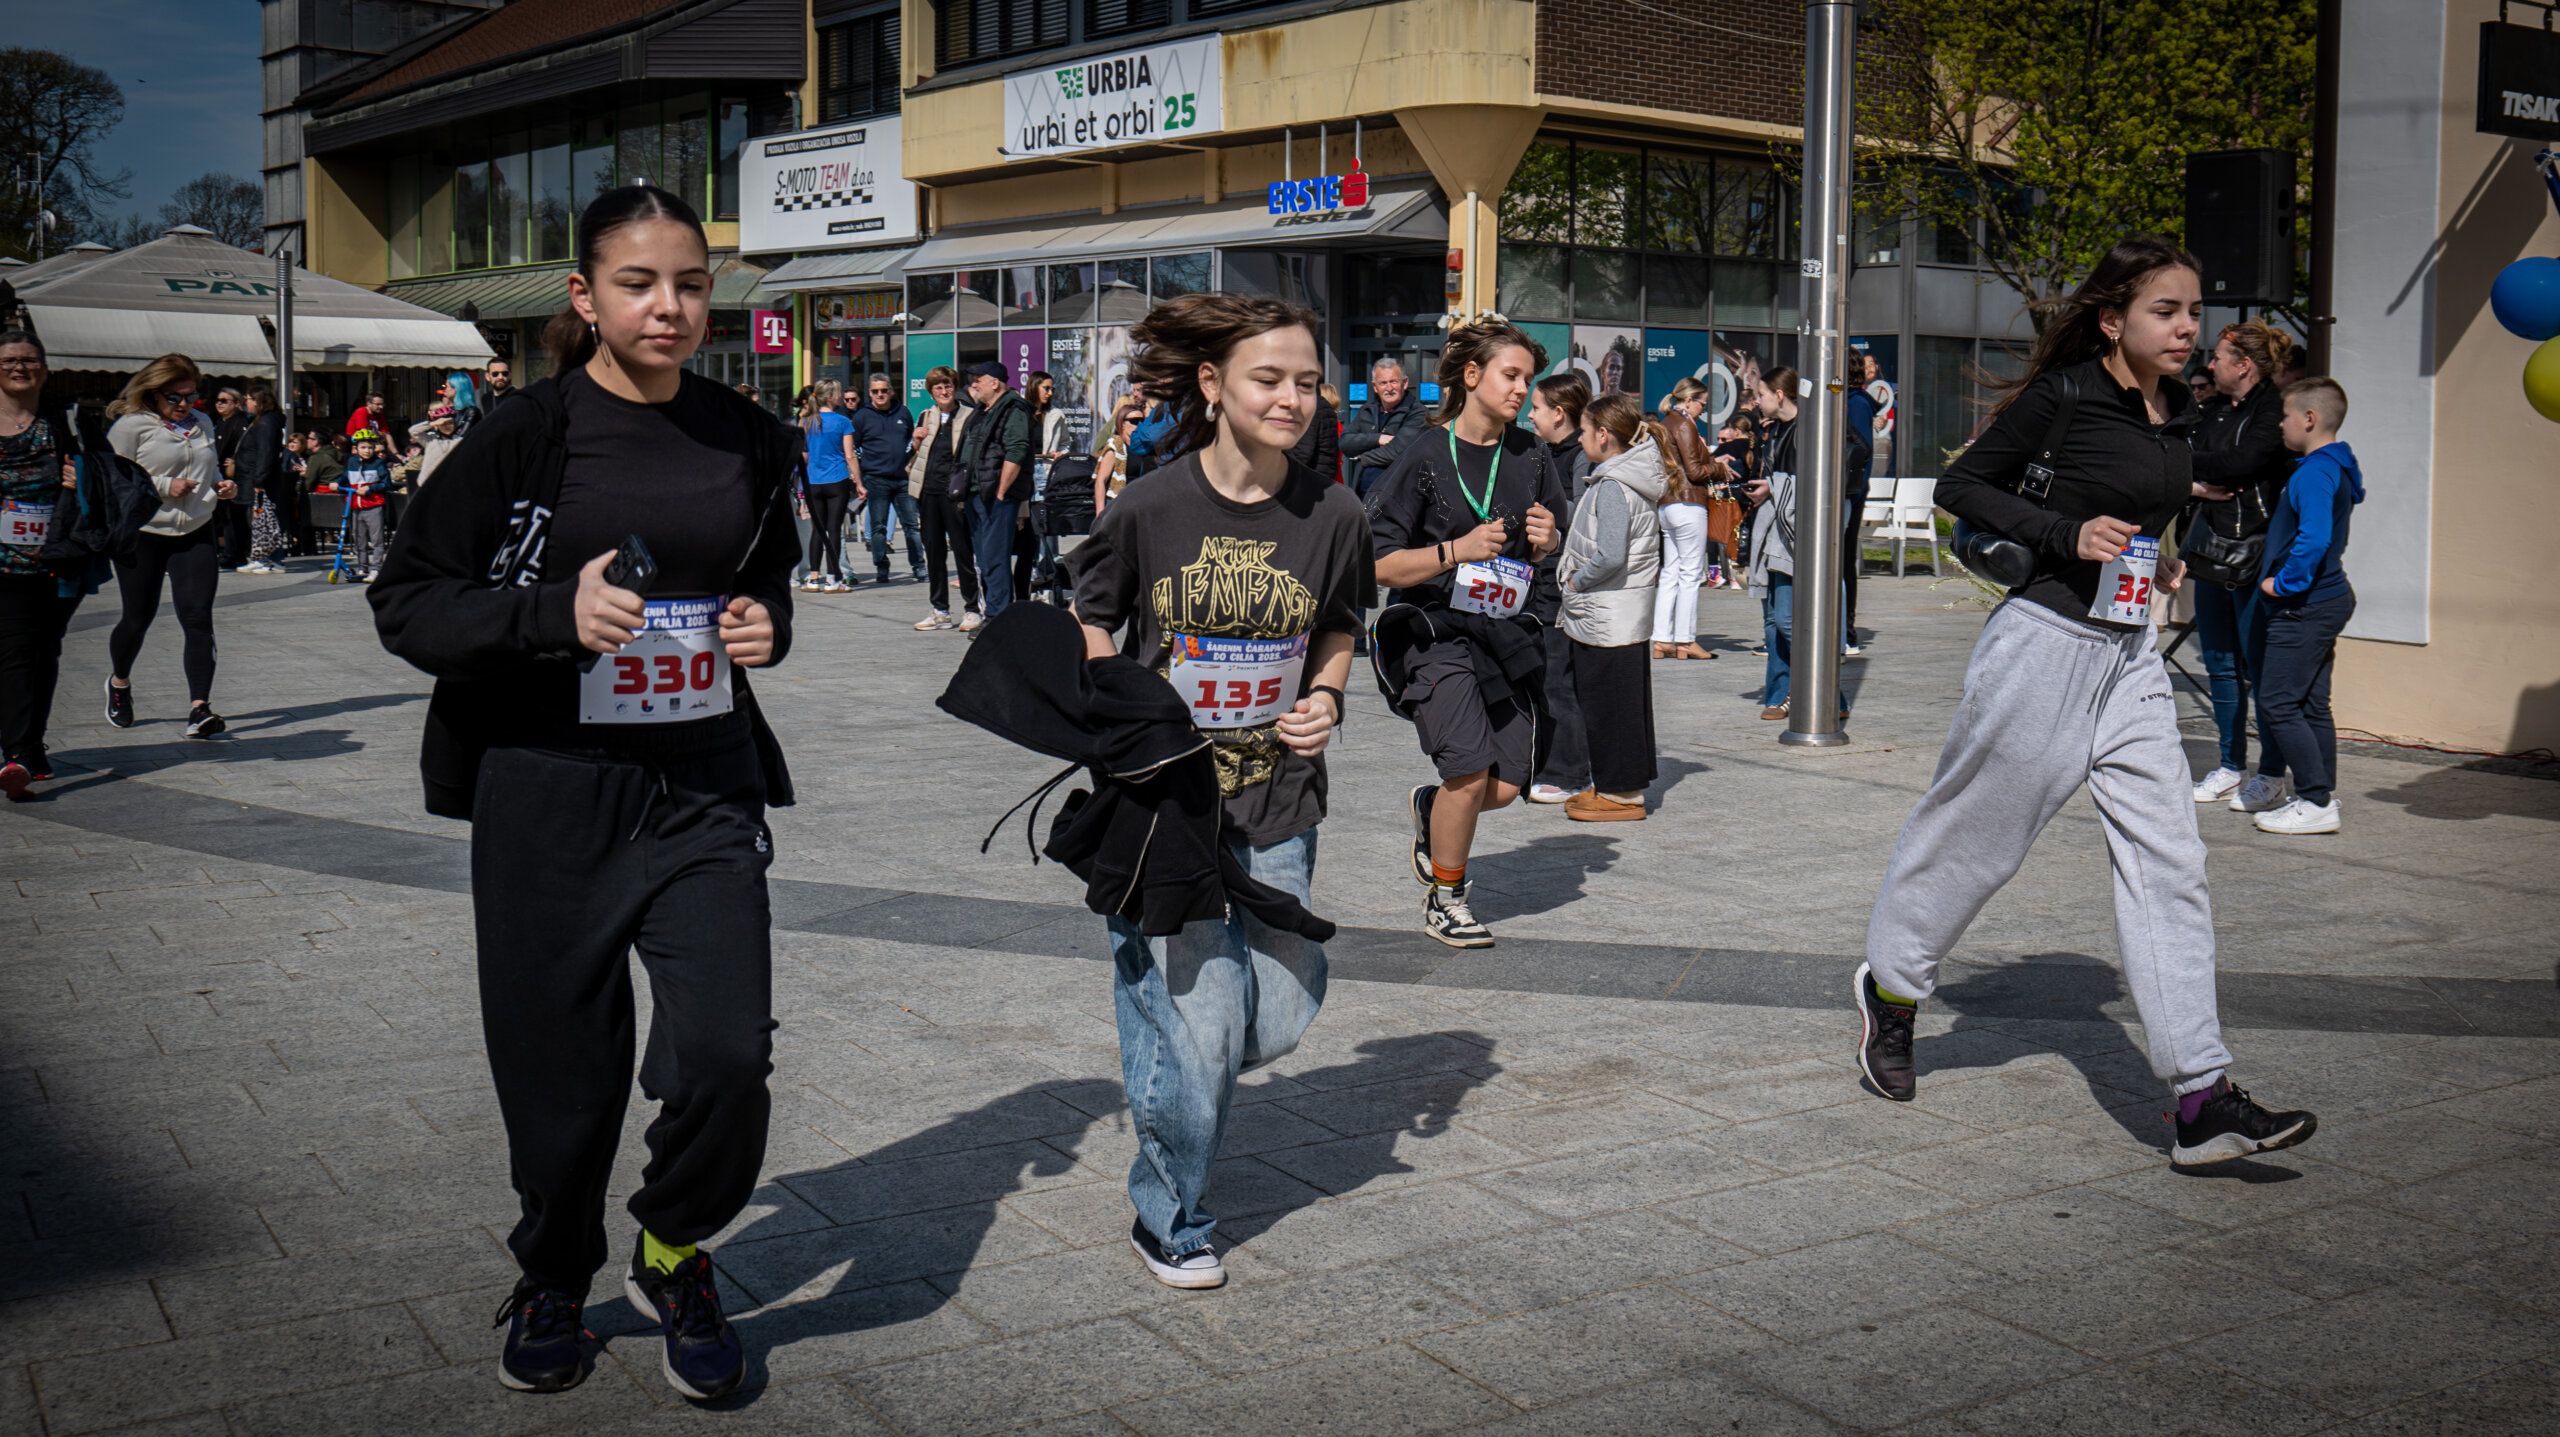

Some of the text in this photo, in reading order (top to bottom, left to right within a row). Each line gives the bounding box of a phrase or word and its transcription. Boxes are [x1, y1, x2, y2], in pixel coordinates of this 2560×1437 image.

[1087, 55, 1152, 96] URBIA
[1023, 93, 1196, 150] urbi et orbi 25
[2502, 90, 2560, 123] TISAK
[775, 161, 875, 196] S-MOTO TEAM d.o.o.
[1269, 175, 1340, 215] ERSTE
[846, 294, 895, 319] BASHA
[1053, 340, 1073, 351] ERSTE
[1648, 348, 1669, 357] ERSTE
[1468, 578, 1517, 609] 270
[2114, 573, 2154, 605] 32
[643, 602, 717, 617] ENIM ČARAPAMA
[653, 618, 683, 629] CILJA
[1206, 641, 1292, 653] ŠARENIM ČARAPAMA
[1213, 653, 1226, 661] DO
[1230, 653, 1254, 662] CILJA
[613, 651, 715, 694] 330
[1194, 677, 1282, 708] 135
